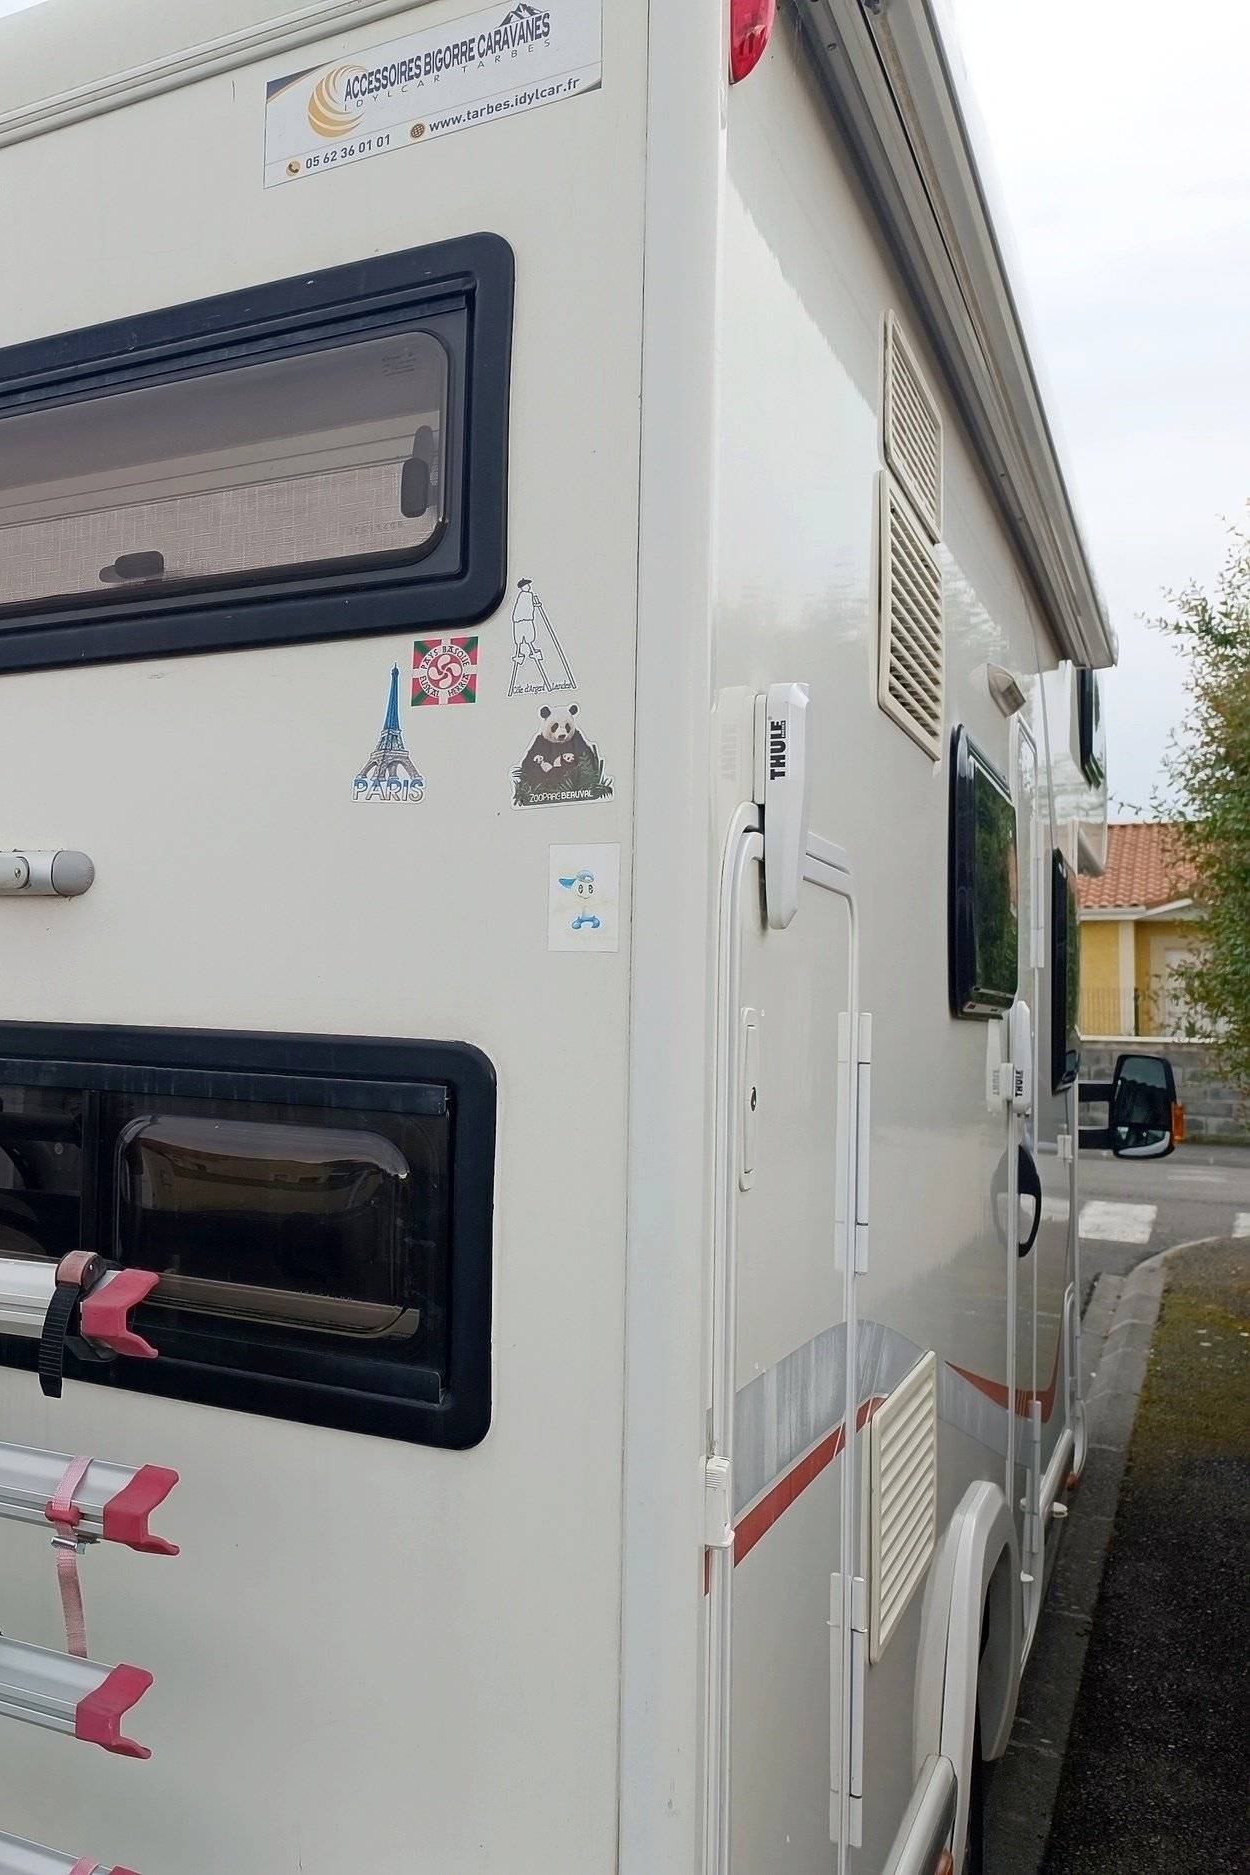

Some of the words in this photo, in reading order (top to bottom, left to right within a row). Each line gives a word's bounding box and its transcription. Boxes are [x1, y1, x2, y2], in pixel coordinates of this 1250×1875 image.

[344, 54, 422, 102] ACCESSOIRES
[424, 37, 476, 77] BIGORRE
[477, 12, 551, 58] CARAVANES
[344, 74, 440, 112] IDYLCAR
[461, 39, 551, 74] TARBES
[428, 76, 581, 133] www.tarbes.idylcar.fr
[305, 156, 320, 170] 05
[323, 150, 338, 165] 62
[340, 145, 355, 160] 36
[358, 139, 373, 154] 01
[376, 133, 391, 149] 01
[421, 648, 438, 670] PAYS
[442, 645, 470, 667] BASQUE
[420, 675, 440, 698] EUSKAL
[448, 673, 470, 697] HERRIA
[769, 720, 787, 781] THULE
[352, 778, 424, 801] PARIS
[1015, 1070, 1023, 1097] THULE
